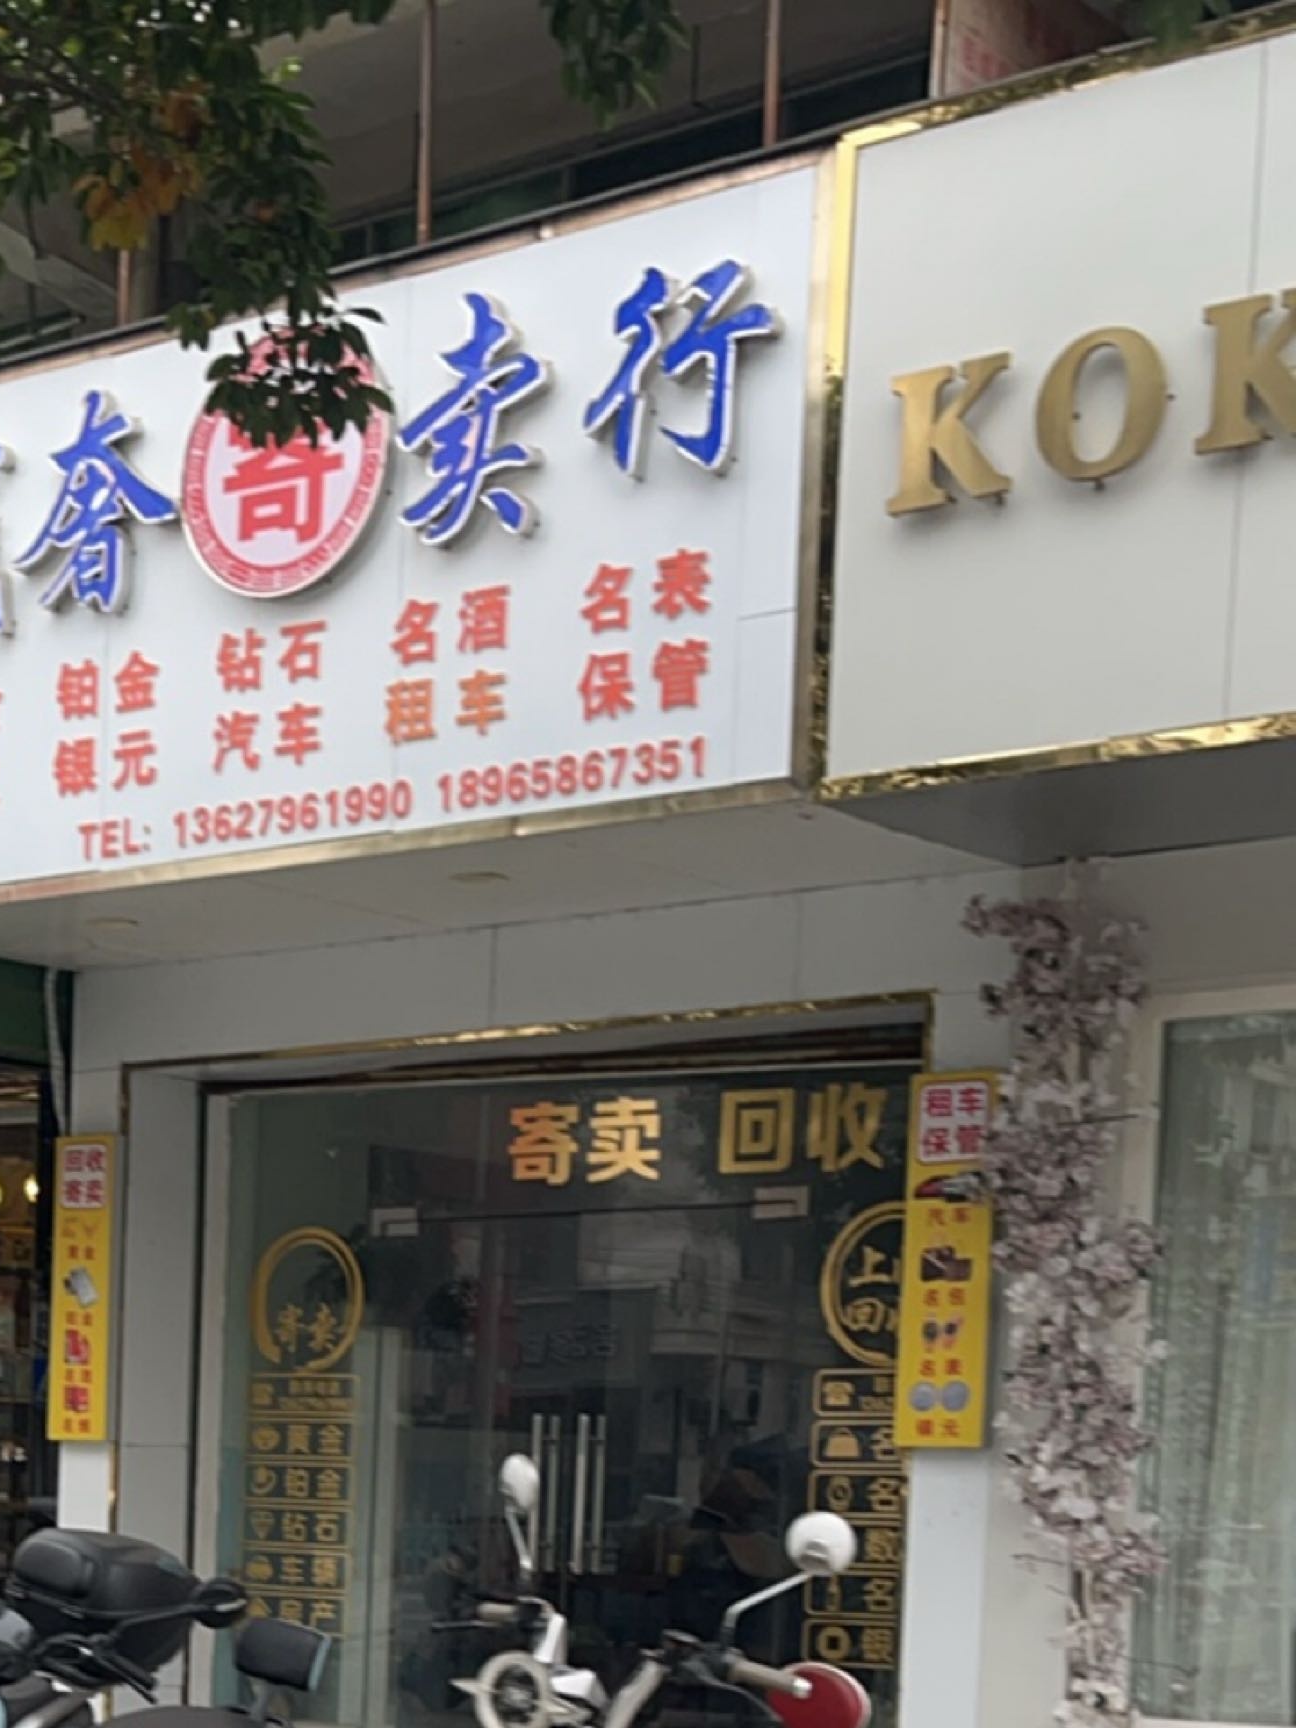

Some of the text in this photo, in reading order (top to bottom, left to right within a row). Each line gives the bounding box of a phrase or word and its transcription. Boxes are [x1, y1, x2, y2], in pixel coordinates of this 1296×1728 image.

[886, 285, 1296, 517] KOK
[56, 650, 160, 720] 铂金
[216, 619, 327, 693] 钻石
[390, 584, 511, 666] 名酒
[581, 548, 711, 635] 名表
[54, 729, 157, 797] 银元
[213, 701, 324, 774] 汽车
[384, 669, 507, 747] 租车
[578, 639, 709, 722] 保管
[78, 736, 706, 861] TEL: 13627961990 18965867351
[509, 1082, 888, 1187] 寄卖 回收
[848, 1246, 901, 1288] 上
[281, 1512, 340, 1541] 钻石
